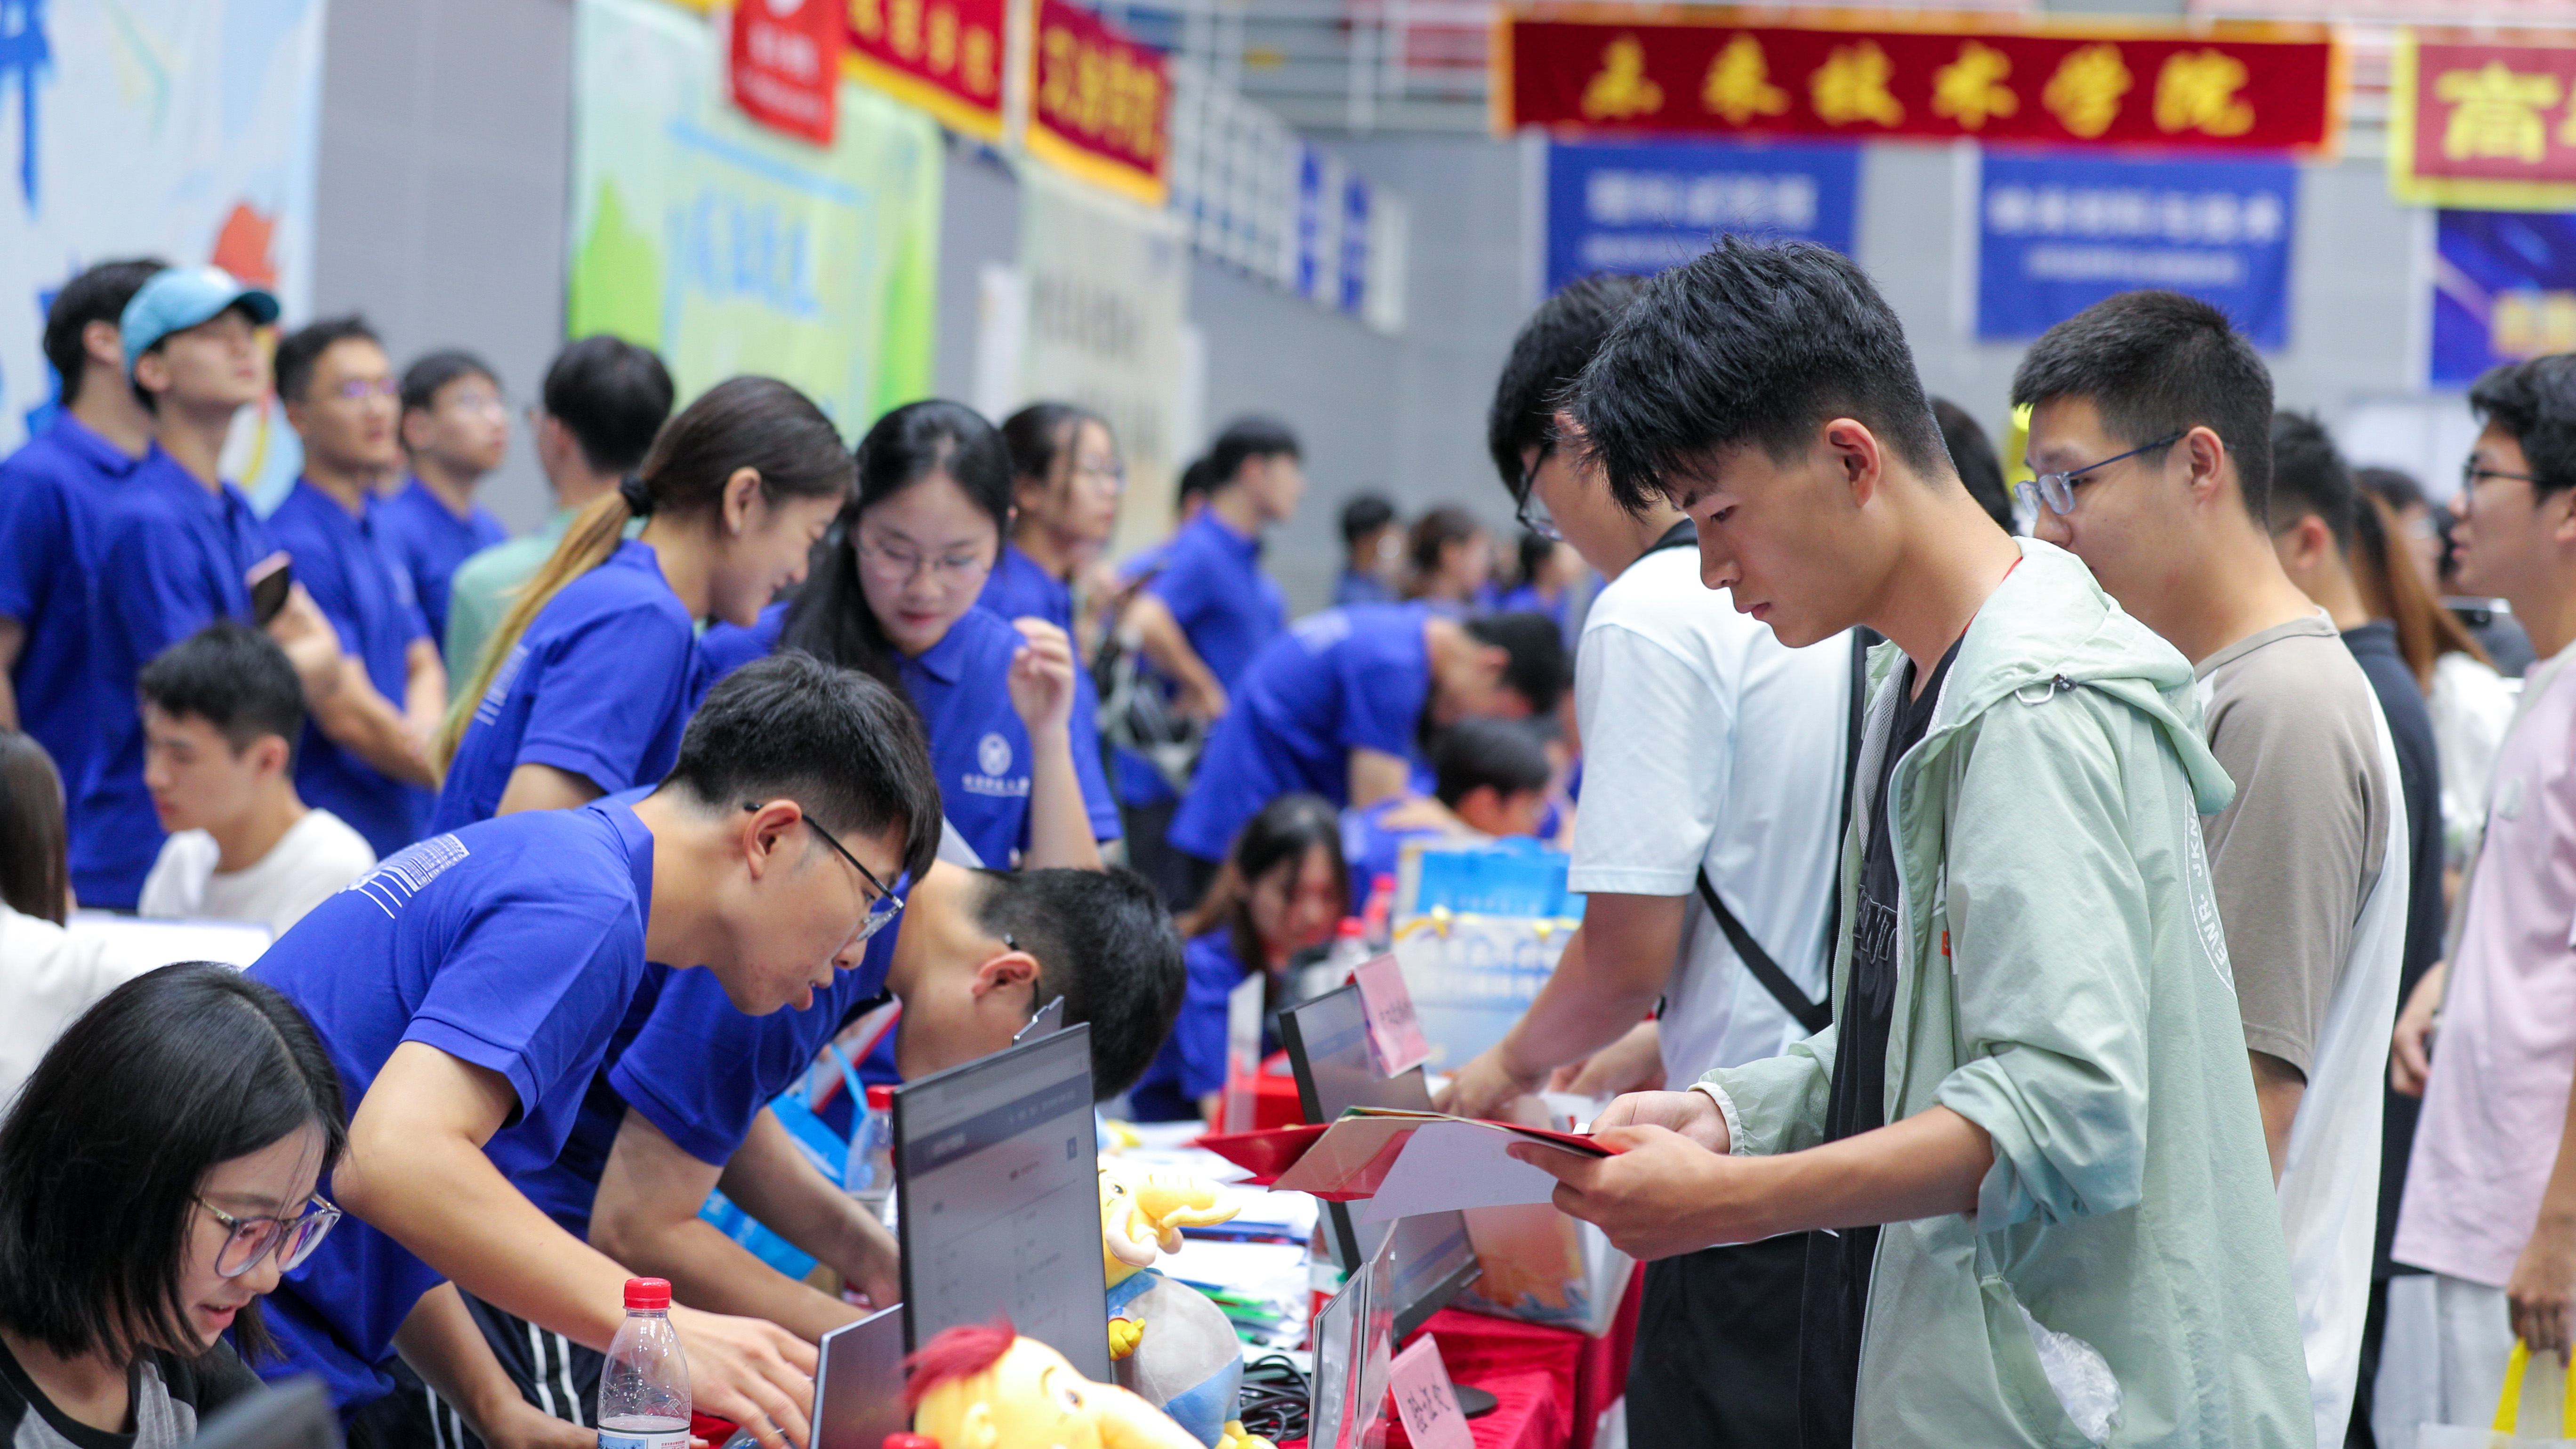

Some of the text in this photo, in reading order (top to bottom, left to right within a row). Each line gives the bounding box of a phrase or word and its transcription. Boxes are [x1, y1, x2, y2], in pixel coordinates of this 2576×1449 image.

[1582, 34, 2256, 138] 未来技术学院
[2432, 59, 2576, 165] 高
